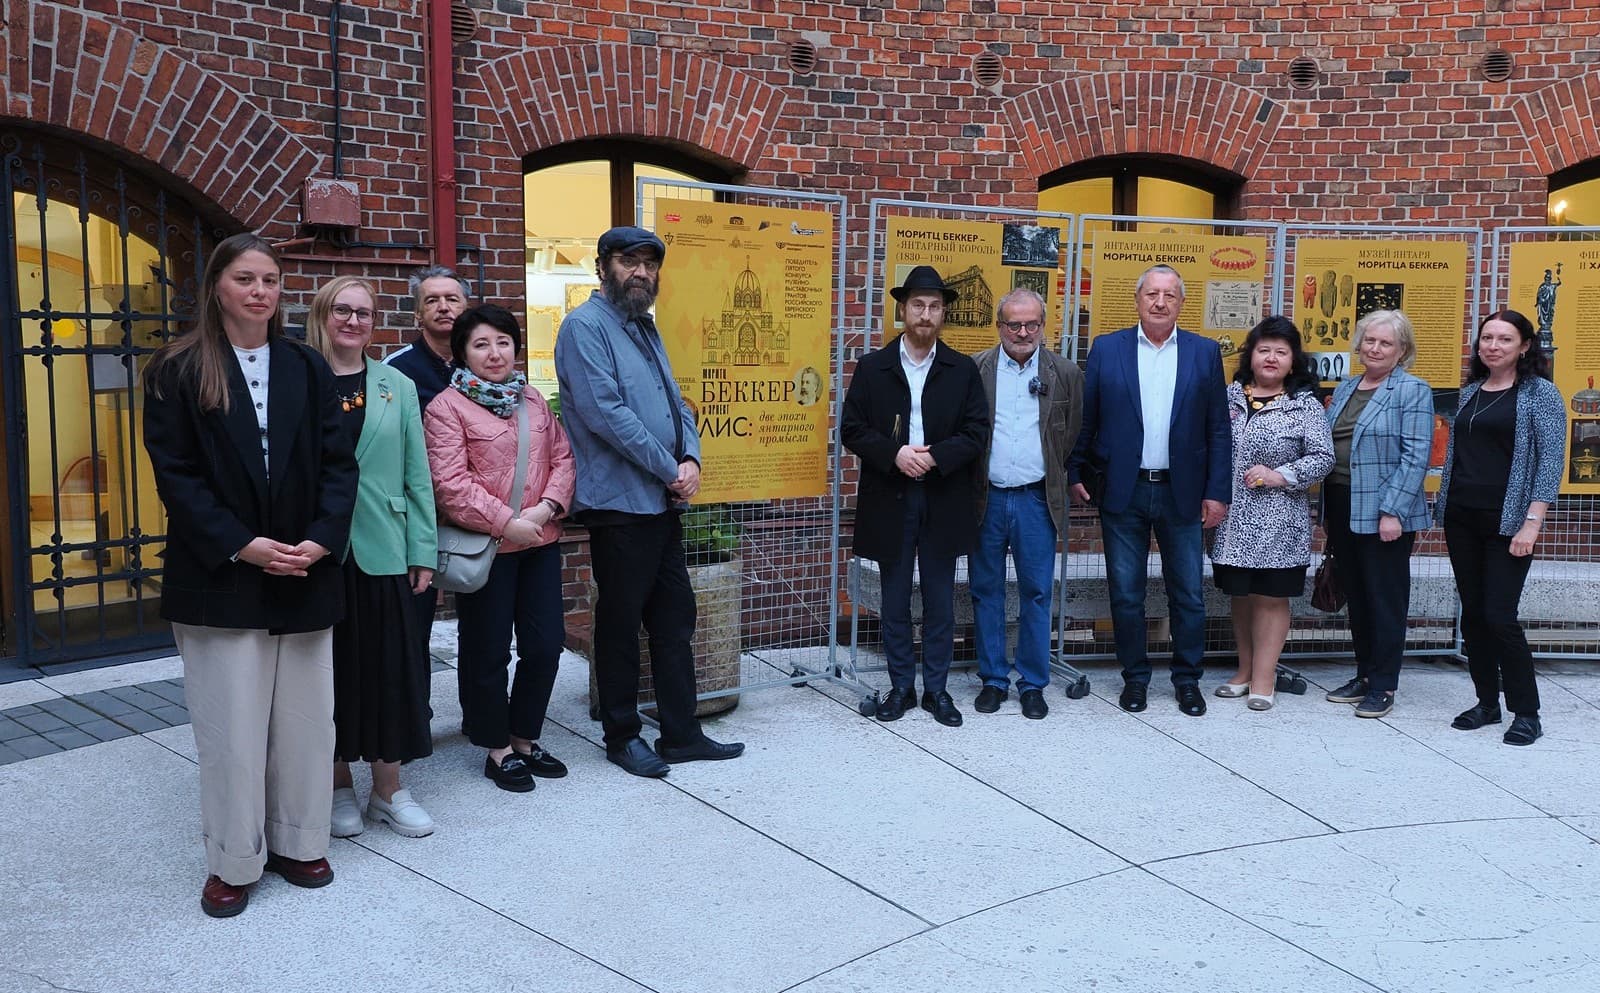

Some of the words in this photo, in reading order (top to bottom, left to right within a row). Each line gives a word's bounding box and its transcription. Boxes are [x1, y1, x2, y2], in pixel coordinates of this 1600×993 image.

[896, 229, 940, 240] МОРИТЦ
[943, 232, 979, 242] БЕККЕР
[1104, 241, 1156, 251] ЯНТАРНАЯ
[1159, 243, 1205, 253] ИМПЕРИЯ
[1103, 253, 1153, 262] МОРИТЦА
[1155, 254, 1196, 263] БЕККЕРА
[1358, 248, 1390, 258] МУЗЕЙ
[1393, 250, 1431, 259] ЯНТАРЯ
[785, 258, 818, 266] ПОБЕДИТЕЛЬ
[1358, 261, 1406, 270] МОРИТЦА
[1409, 261, 1449, 270] БЕККЕРА
[784, 272, 812, 280] КОНКУРСА
[702, 368, 727, 380] МОРИТЦ
[700, 380, 796, 403] БЕККЕР
[759, 410, 775, 422] две
[777, 412, 807, 422] эпохи
[698, 416, 753, 438] ЛИС:
[758, 423, 815, 436] янтарного
[759, 434, 809, 447] промысла
